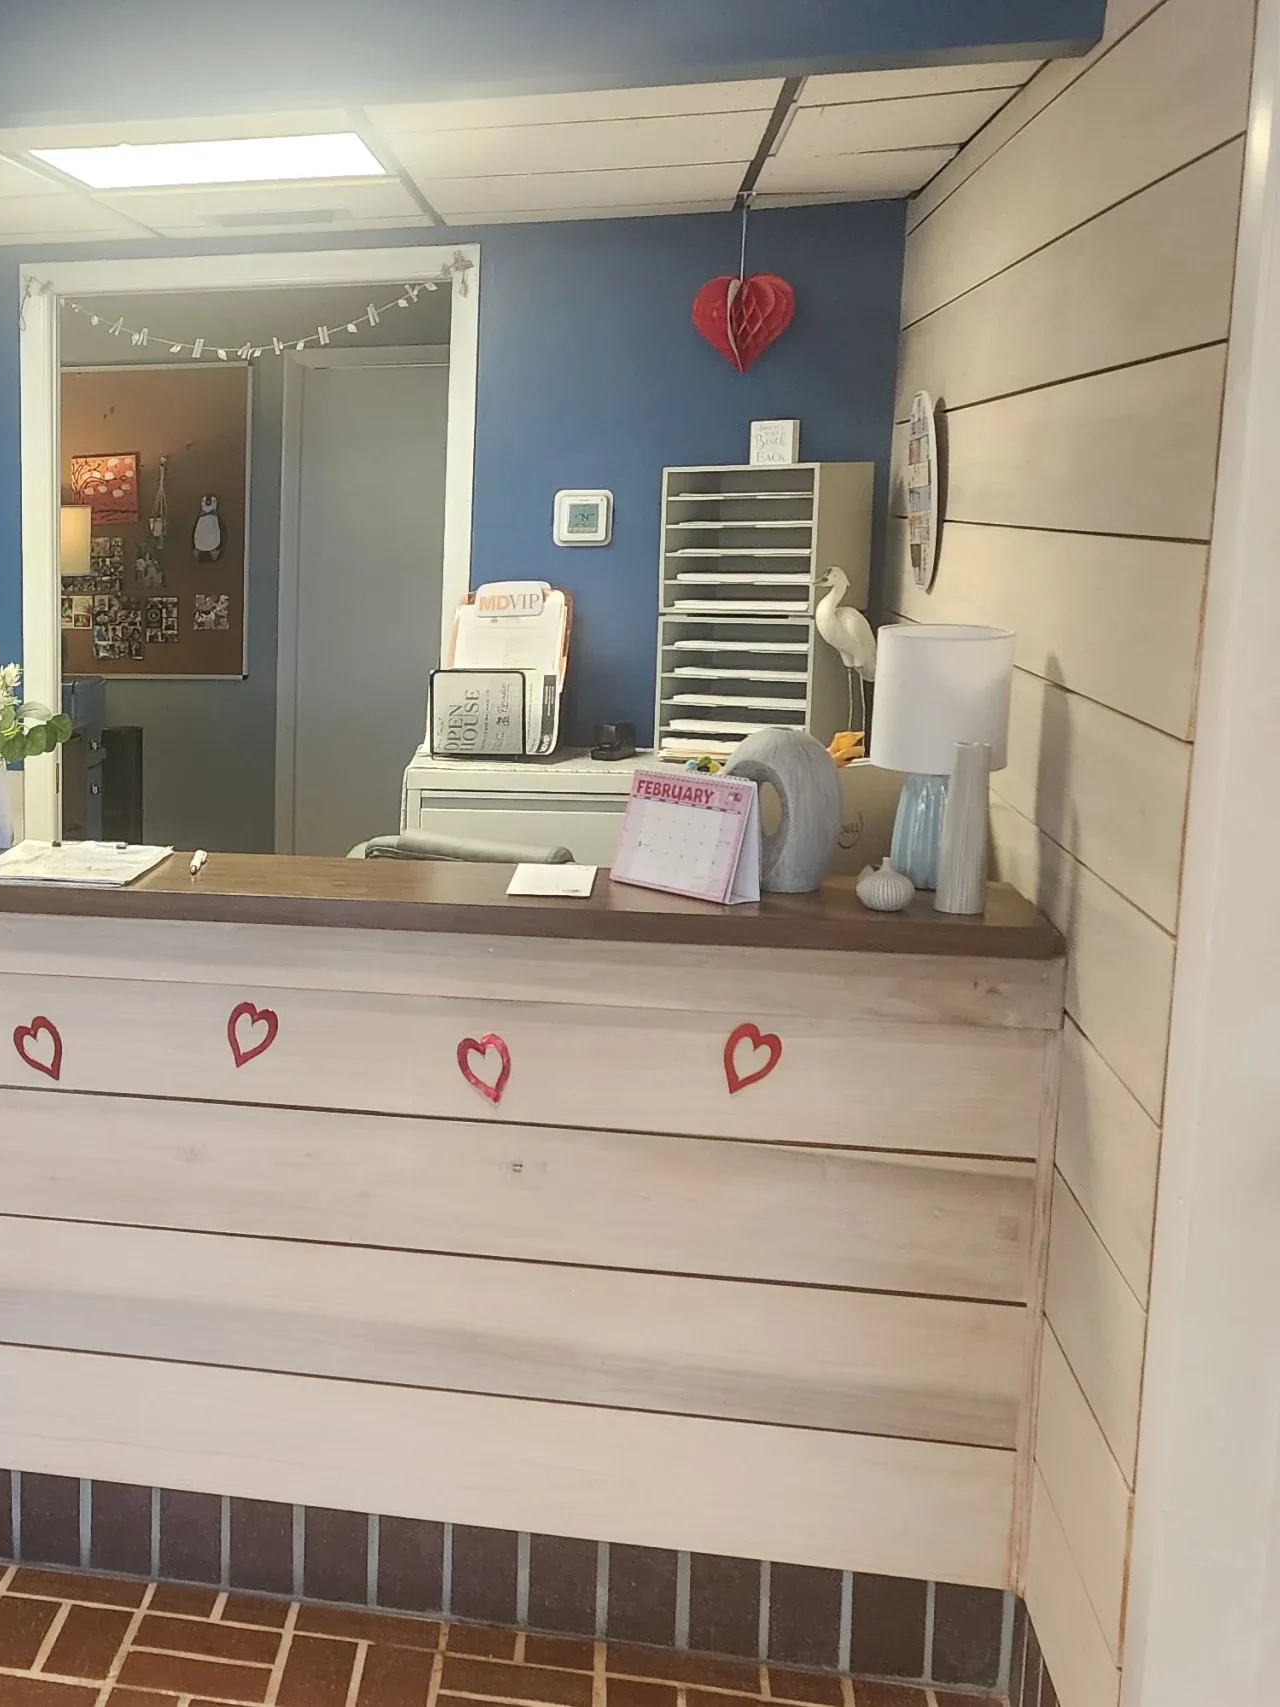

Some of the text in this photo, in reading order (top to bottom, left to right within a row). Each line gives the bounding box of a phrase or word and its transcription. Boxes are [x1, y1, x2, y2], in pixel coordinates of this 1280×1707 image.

[478, 593, 540, 611] MDVIP
[444, 704, 463, 751] OPEN
[459, 690, 480, 751] HOUSE
[636, 779, 715, 805] FEBRUARY
